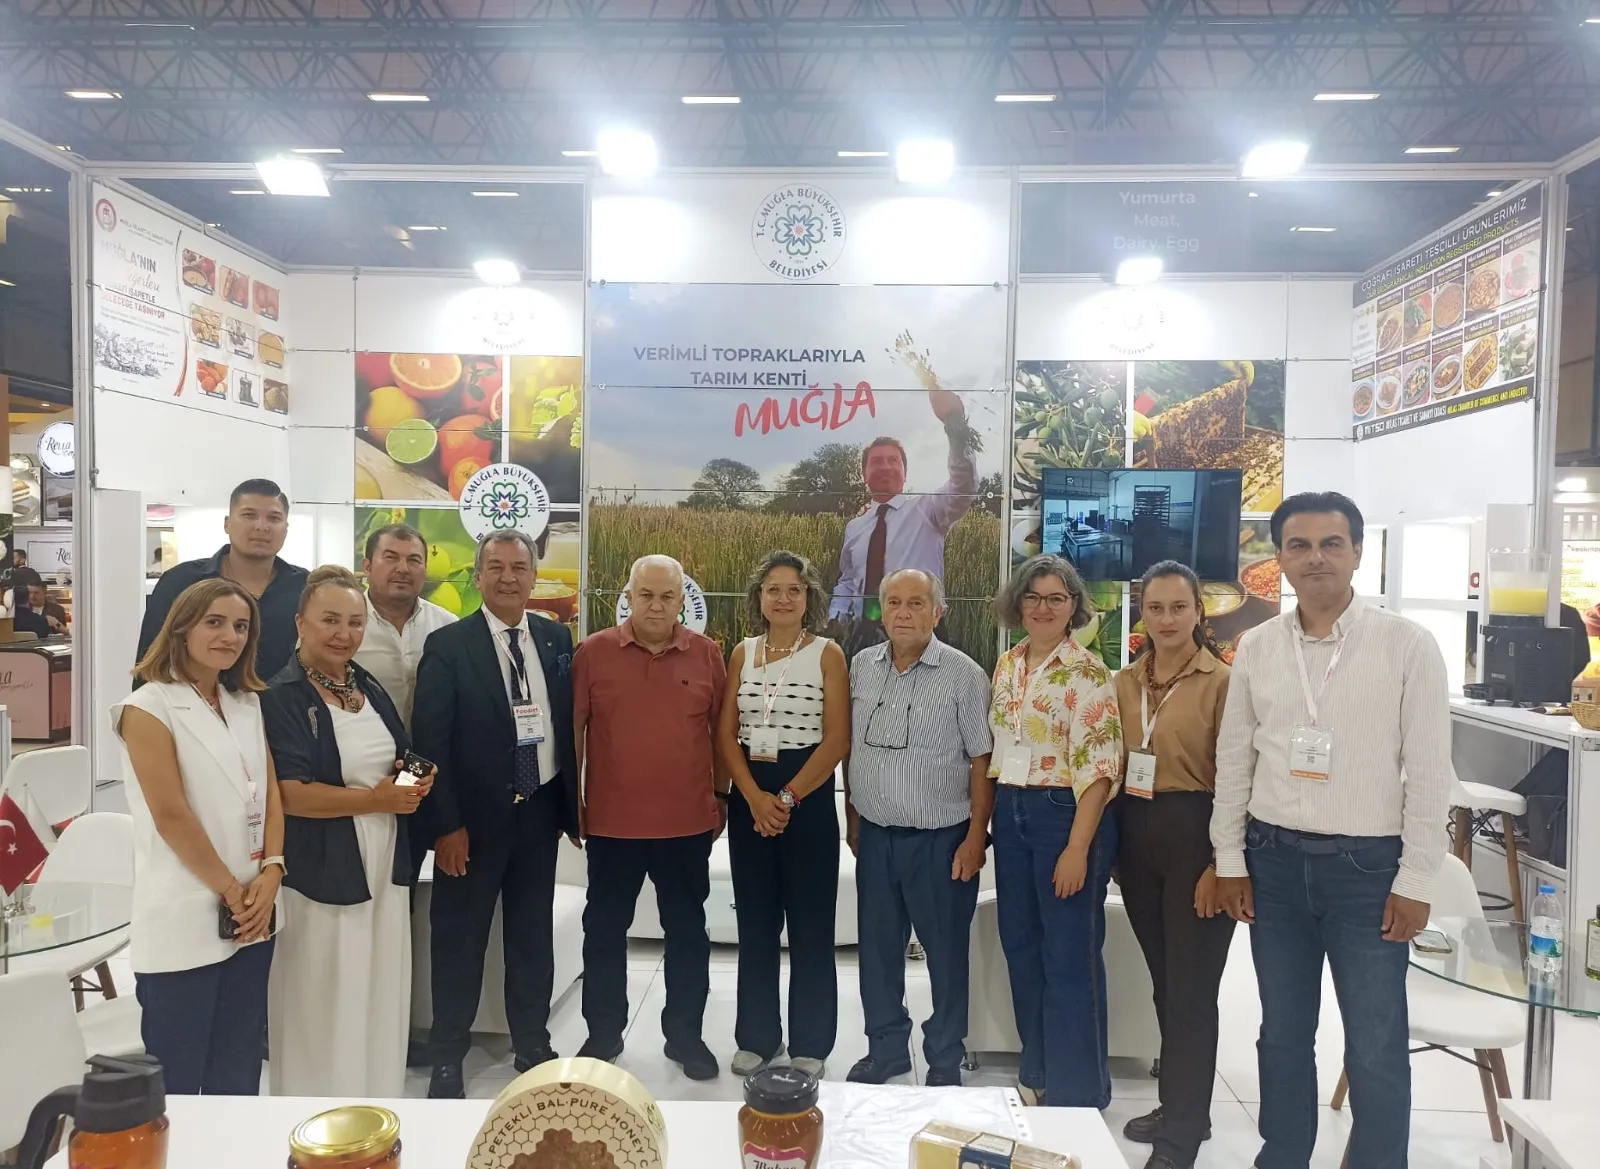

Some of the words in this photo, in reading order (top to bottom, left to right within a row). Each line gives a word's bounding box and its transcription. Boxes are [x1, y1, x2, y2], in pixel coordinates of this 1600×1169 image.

[797, 187, 843, 237] BÜYÜKŞEHİR
[1119, 190, 1196, 204] Yumurta
[1133, 213, 1180, 228] Meat,
[1425, 232, 1460, 259] TESCİLLİ
[1462, 197, 1527, 240] ÜRÜNLERİMİZ
[1113, 235, 1161, 251] Dairy,
[1166, 236, 1199, 252] Egg
[1446, 239, 1482, 260] REGISTERED
[1483, 217, 1519, 241] PRODUCTS
[769, 259, 828, 278] BELEDİYESİ
[633, 344, 707, 361] VERİMLİ
[712, 348, 866, 363] TOPRAKLARIYLA
[690, 371, 747, 385] TARIM
[753, 369, 807, 386] KENTİ
[735, 381, 876, 437] MUĞLA
[503, 466, 547, 512] BÜYÜKŞEHİR
[489, 1106, 532, 1154] PETEKLİ
[610, 1113, 645, 1154] HONEY
